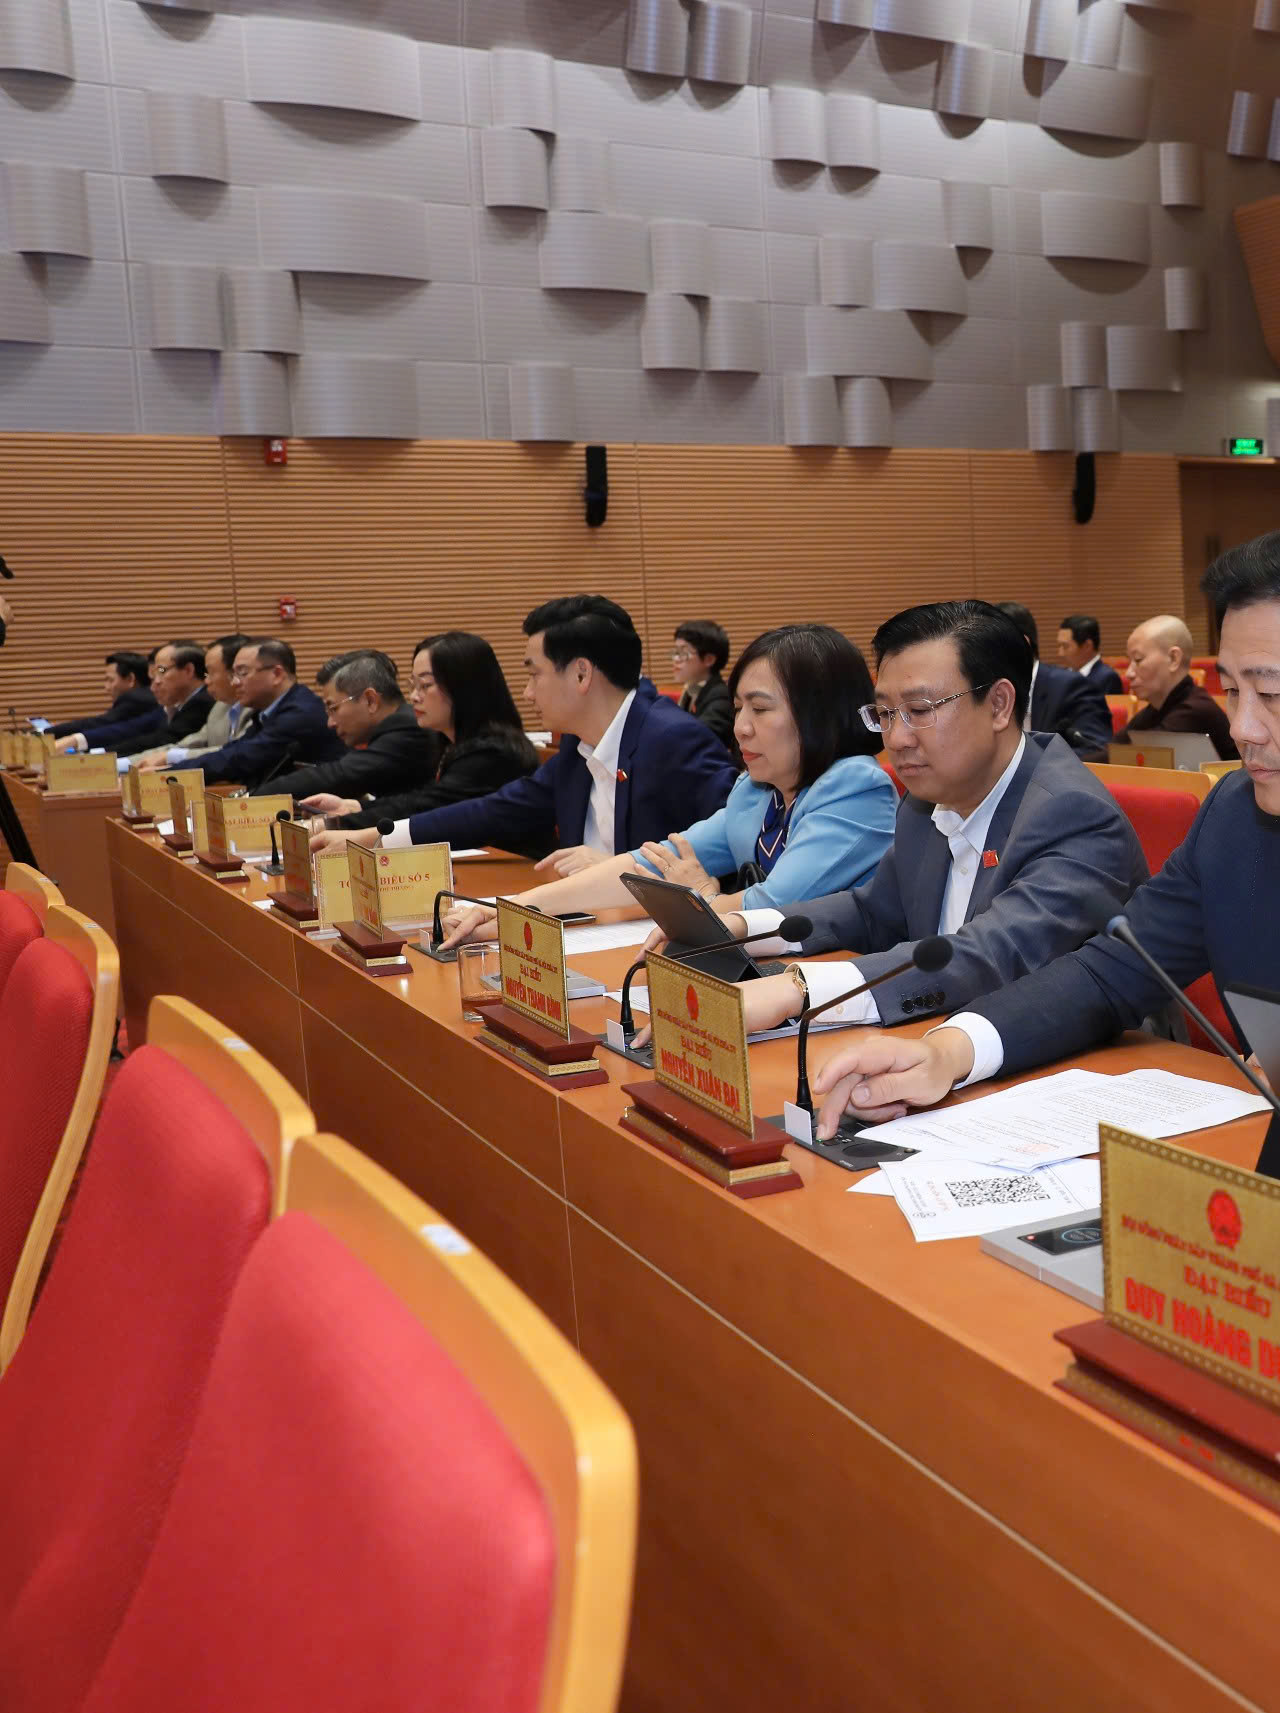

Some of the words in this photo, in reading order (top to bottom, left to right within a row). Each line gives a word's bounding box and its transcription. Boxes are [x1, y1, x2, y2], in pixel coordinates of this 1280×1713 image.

[425, 873, 430, 881] 5
[1184, 1264, 1218, 1297] ĐẠI
[1224, 1279, 1272, 1320] BIỂU
[1124, 1276, 1166, 1327] DUY
[1171, 1297, 1253, 1370] HOÀNG
